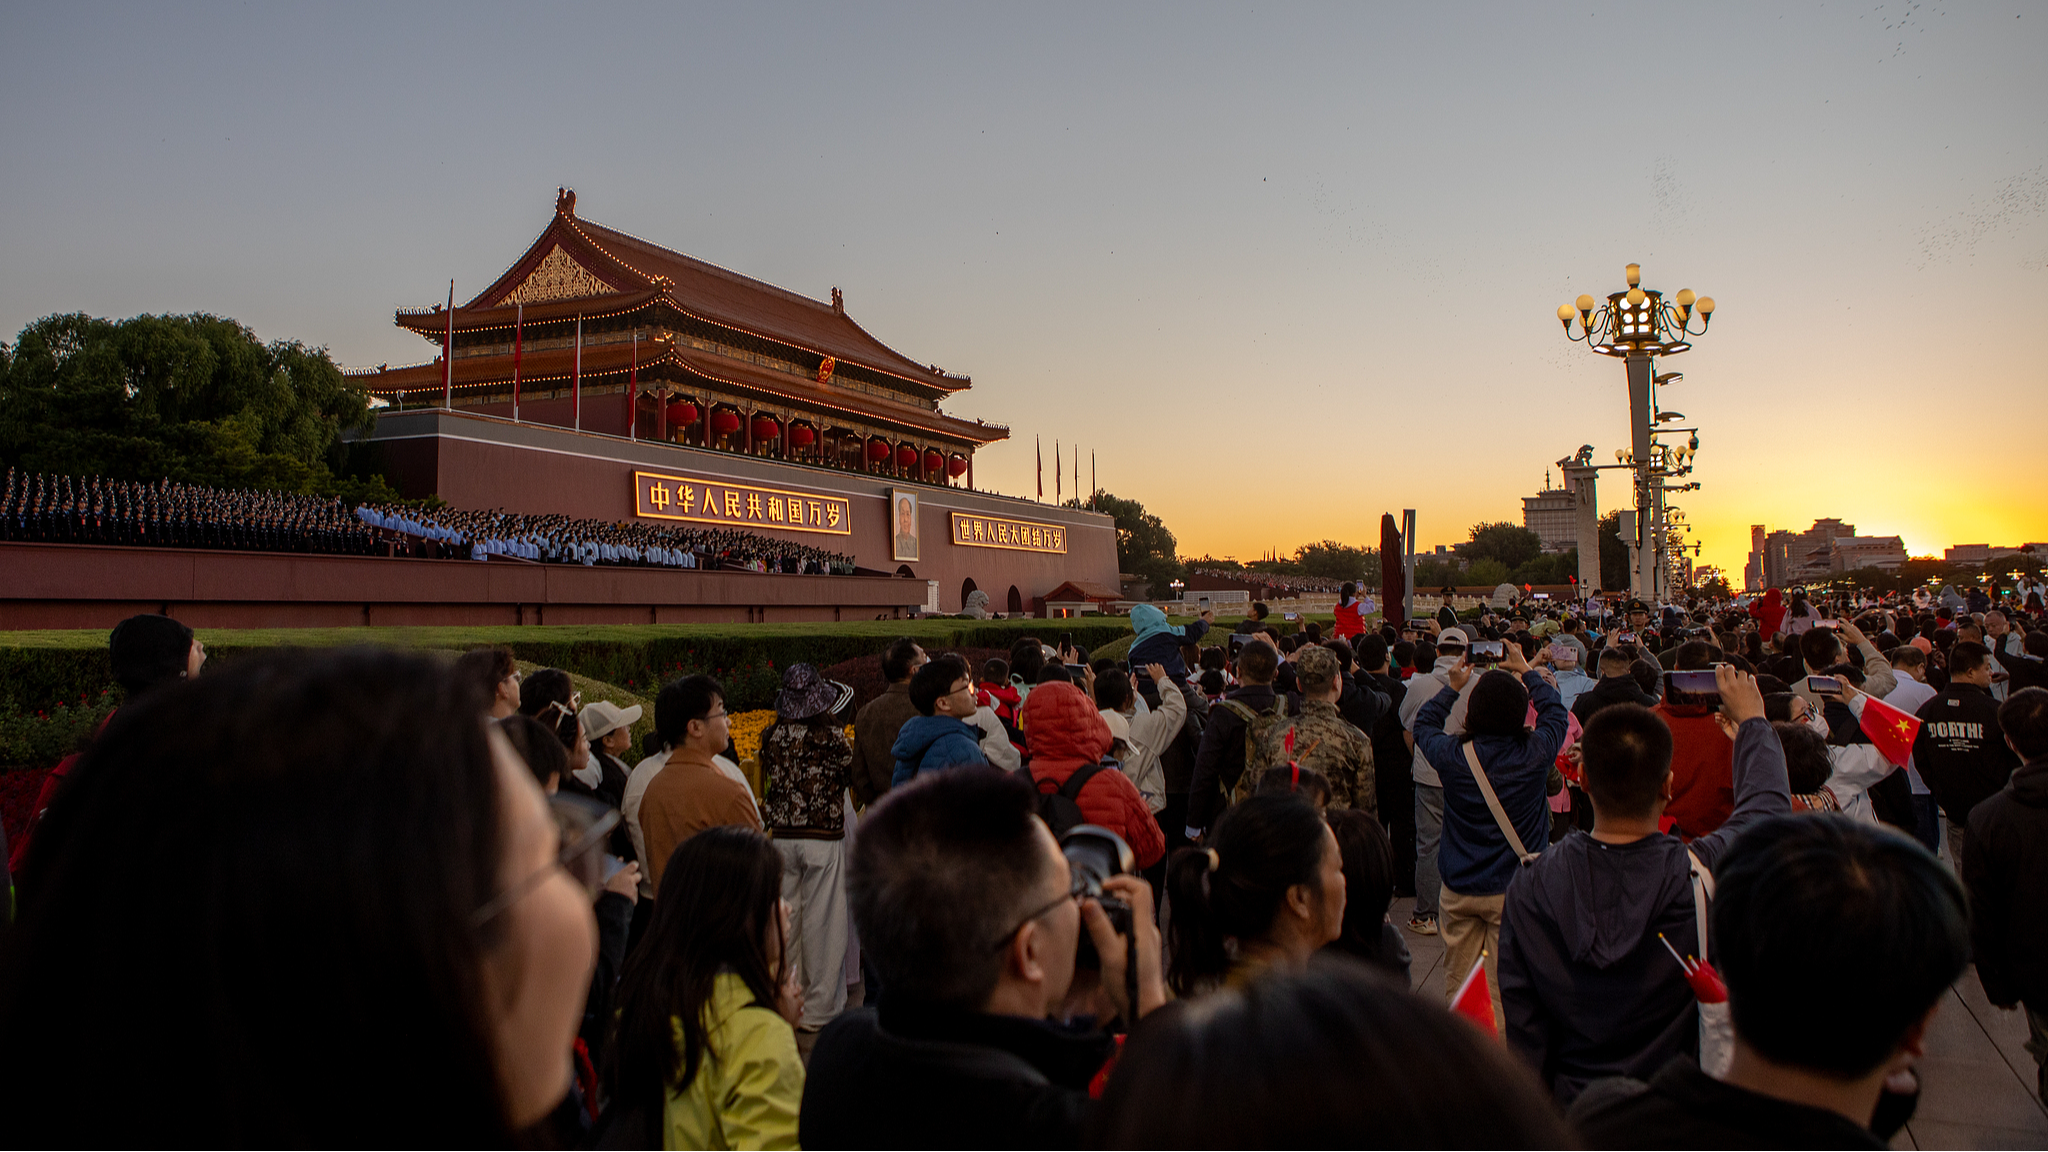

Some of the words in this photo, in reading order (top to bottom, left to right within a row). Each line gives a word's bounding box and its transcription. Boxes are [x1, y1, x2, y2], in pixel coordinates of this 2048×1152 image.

[649, 481, 840, 528] 中华人民共和国万岁
[960, 519, 1061, 549] 世界人民大团结万岁
